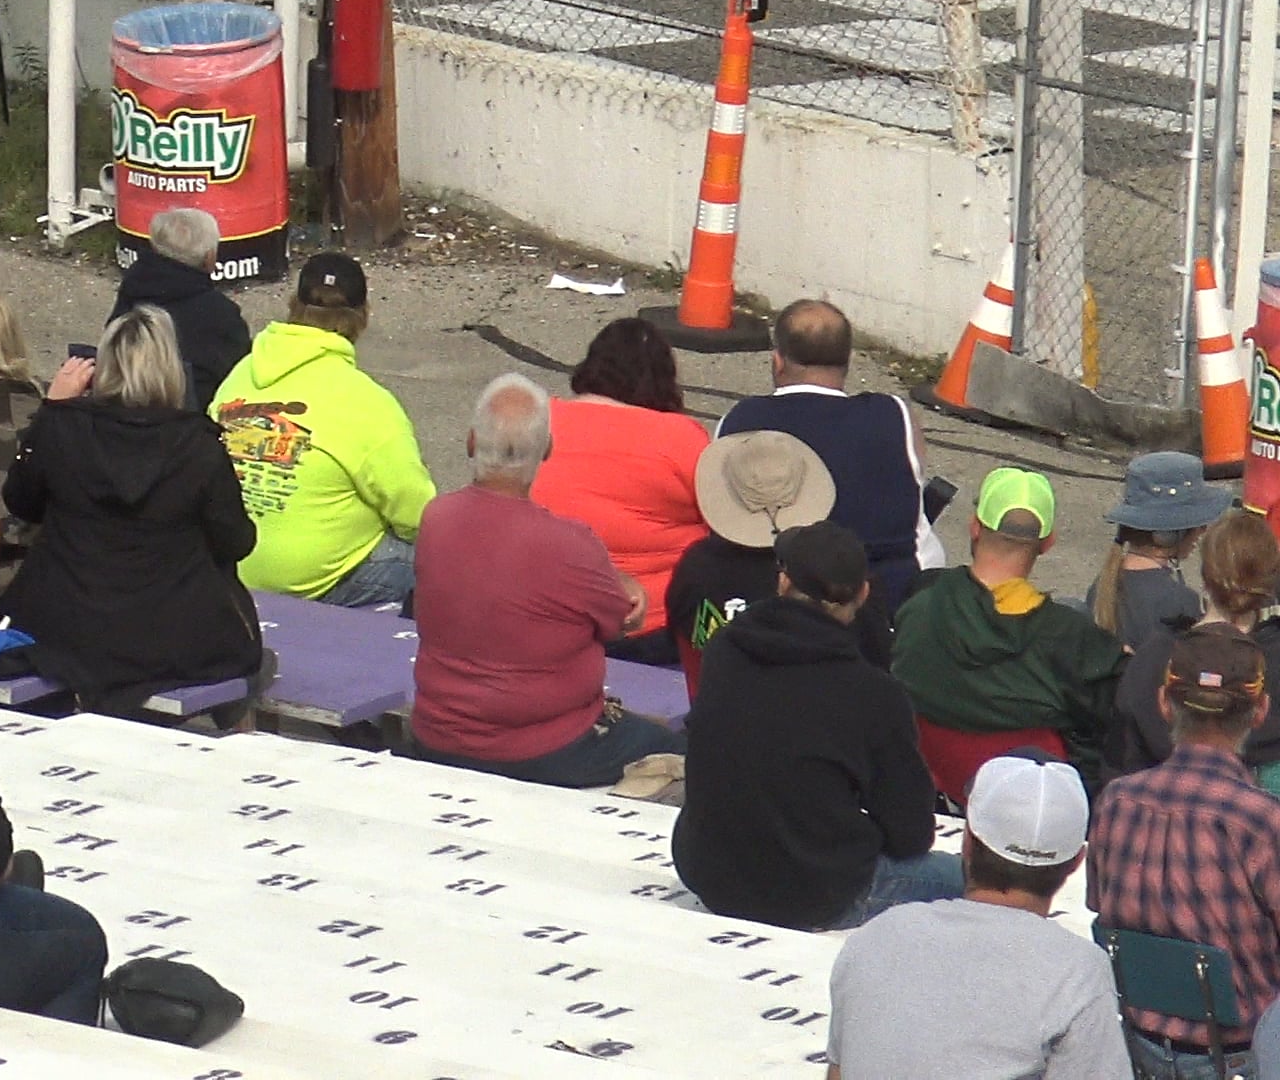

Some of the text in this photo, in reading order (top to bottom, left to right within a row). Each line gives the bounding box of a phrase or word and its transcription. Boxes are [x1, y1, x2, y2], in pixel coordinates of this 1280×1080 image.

[127, 171, 208, 193] AUTO PARTS
[39, 765, 100, 783] 16
[241, 774, 300, 789] 16
[42, 799, 105, 817] 15
[229, 804, 293, 822] 15
[432, 812, 493, 829] 15
[243, 838, 305, 857] 14
[427, 844, 490, 862] 14
[256, 873, 320, 892] 13
[444, 878, 507, 897] 13
[124, 910, 192, 930] 12
[317, 919, 384, 939] 12
[522, 925, 589, 945] 12
[706, 930, 772, 949] 12
[343, 955, 408, 974] 11
[535, 962, 603, 983] 11
[740, 967, 803, 987] 11
[348, 990, 419, 1010] 10
[565, 1001, 635, 1020] 10
[759, 1006, 828, 1027] 10
